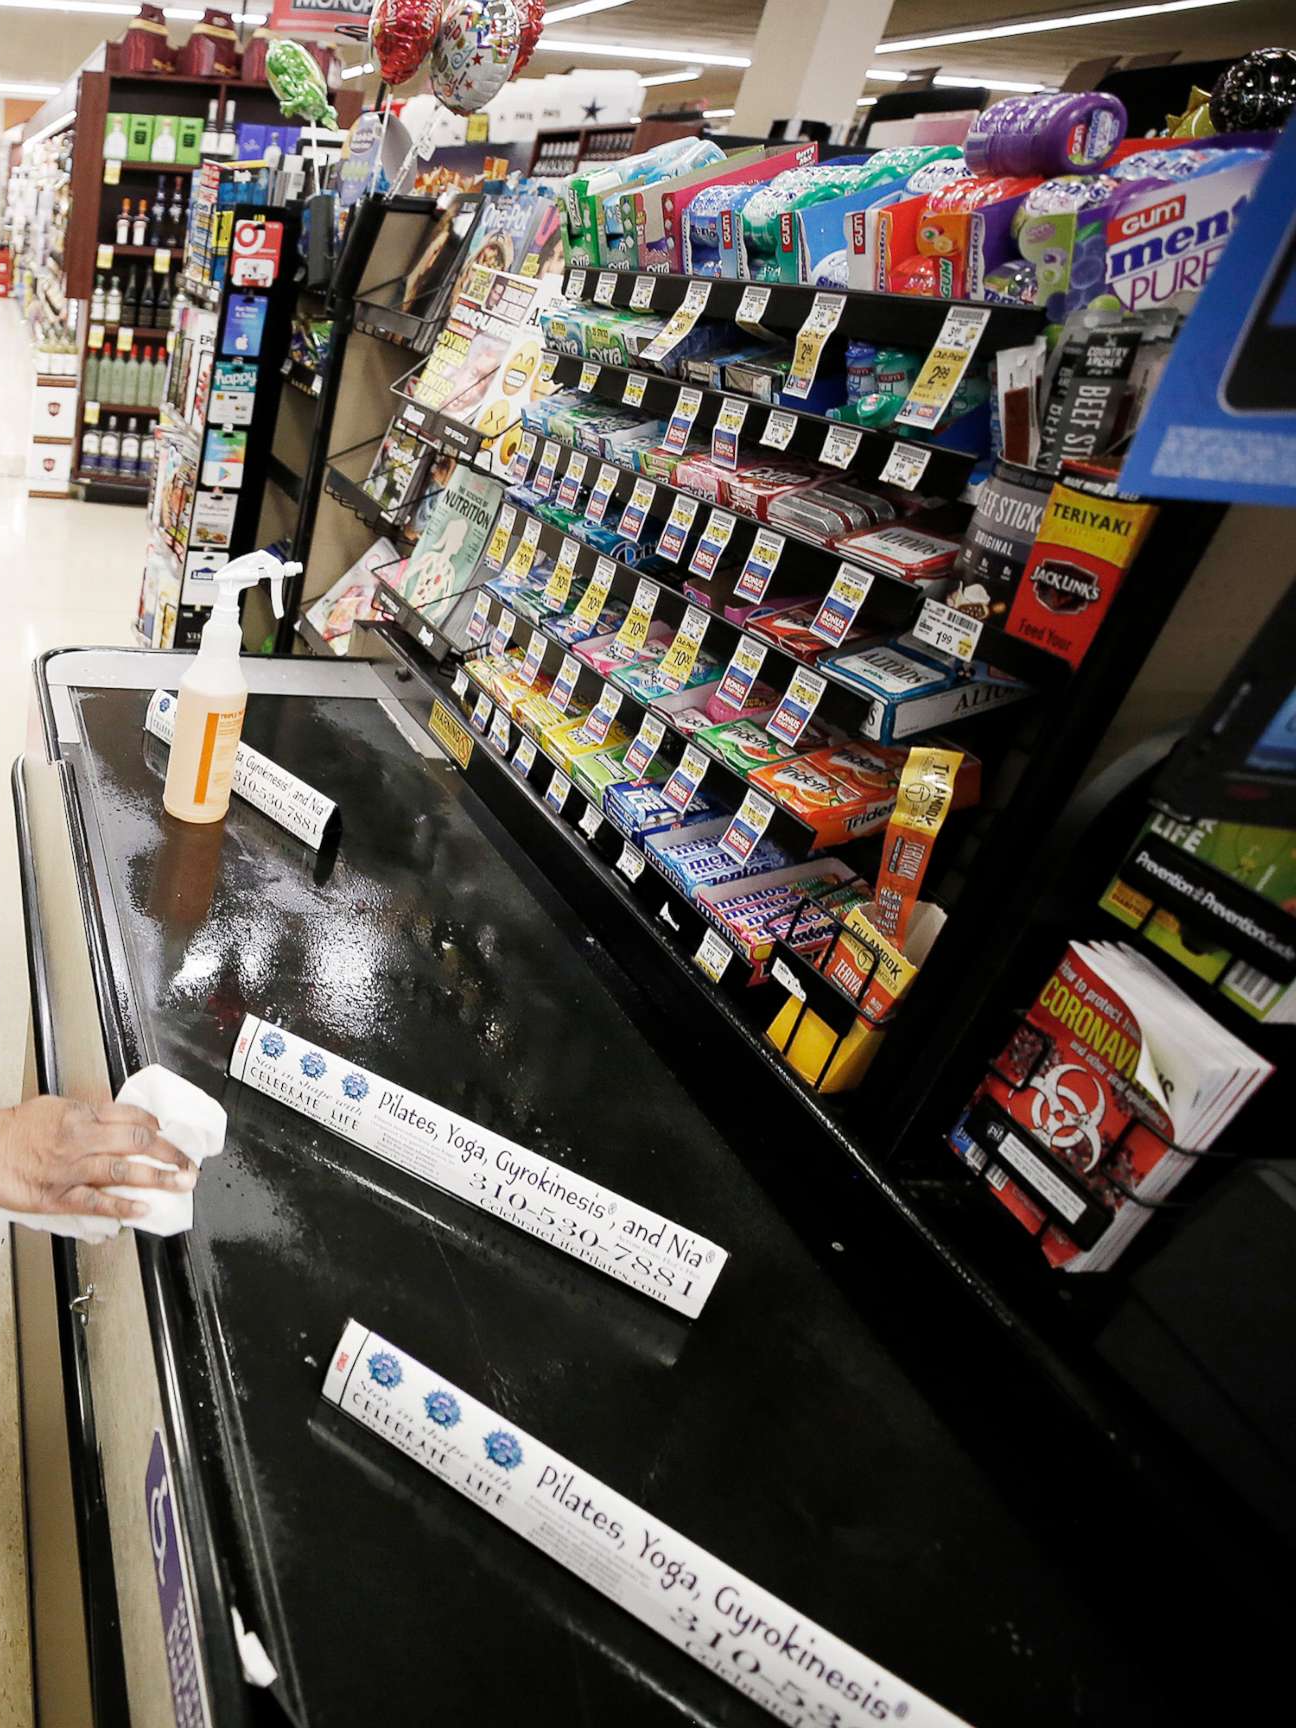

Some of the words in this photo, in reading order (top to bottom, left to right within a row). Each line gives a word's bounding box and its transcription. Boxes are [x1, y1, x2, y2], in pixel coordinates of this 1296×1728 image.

[1120, 201, 1181, 235] GUM
[969, 217, 982, 291] mentos
[940, 260, 954, 299] GUM
[1086, 346, 1129, 359] COUNTRY
[1086, 356, 1123, 369] ARCHER
[214, 367, 256, 388] happy
[1070, 386, 1111, 429] BEEF
[444, 490, 492, 529] NUTRITION
[1054, 502, 1133, 537] TERIYAKI
[974, 530, 1013, 557] ORIGINAL
[1030, 566, 1063, 591] JACK
[1062, 574, 1101, 601] LINK'S
[1018, 617, 1045, 642] Feed
[862, 651, 931, 686] ALTOIDS
[726, 724, 771, 750] Trident
[785, 764, 832, 795] Trident
[234, 769, 320, 837] 310-530-7881
[1150, 812, 1206, 853] LIFE
[1134, 850, 1195, 897] Prevention
[714, 884, 790, 910] mentos
[851, 920, 903, 982] TILLAMOOK
[1059, 958, 1078, 983] How
[1075, 977, 1088, 993] to
[1084, 988, 1124, 1023] protect
[1070, 1040, 1085, 1056] and
[1085, 1051, 1107, 1075] other
[250, 1065, 321, 1110] CELEBRATE
[330, 1107, 361, 1132] LIFE
[378, 1090, 440, 1141] Pilates,
[446, 1121, 489, 1166] Yoga,
[622, 1220, 668, 1249] and
[469, 1171, 696, 1298] 310-530-7881
[479, 1196, 668, 1303] CelebrateLifePilates.com
[352, 1391, 450, 1466] CELEBRATE
[465, 1471, 509, 1506] LIFE
[536, 1465, 625, 1550] Pilates,
[638, 1529, 701, 1601] Yoga,
